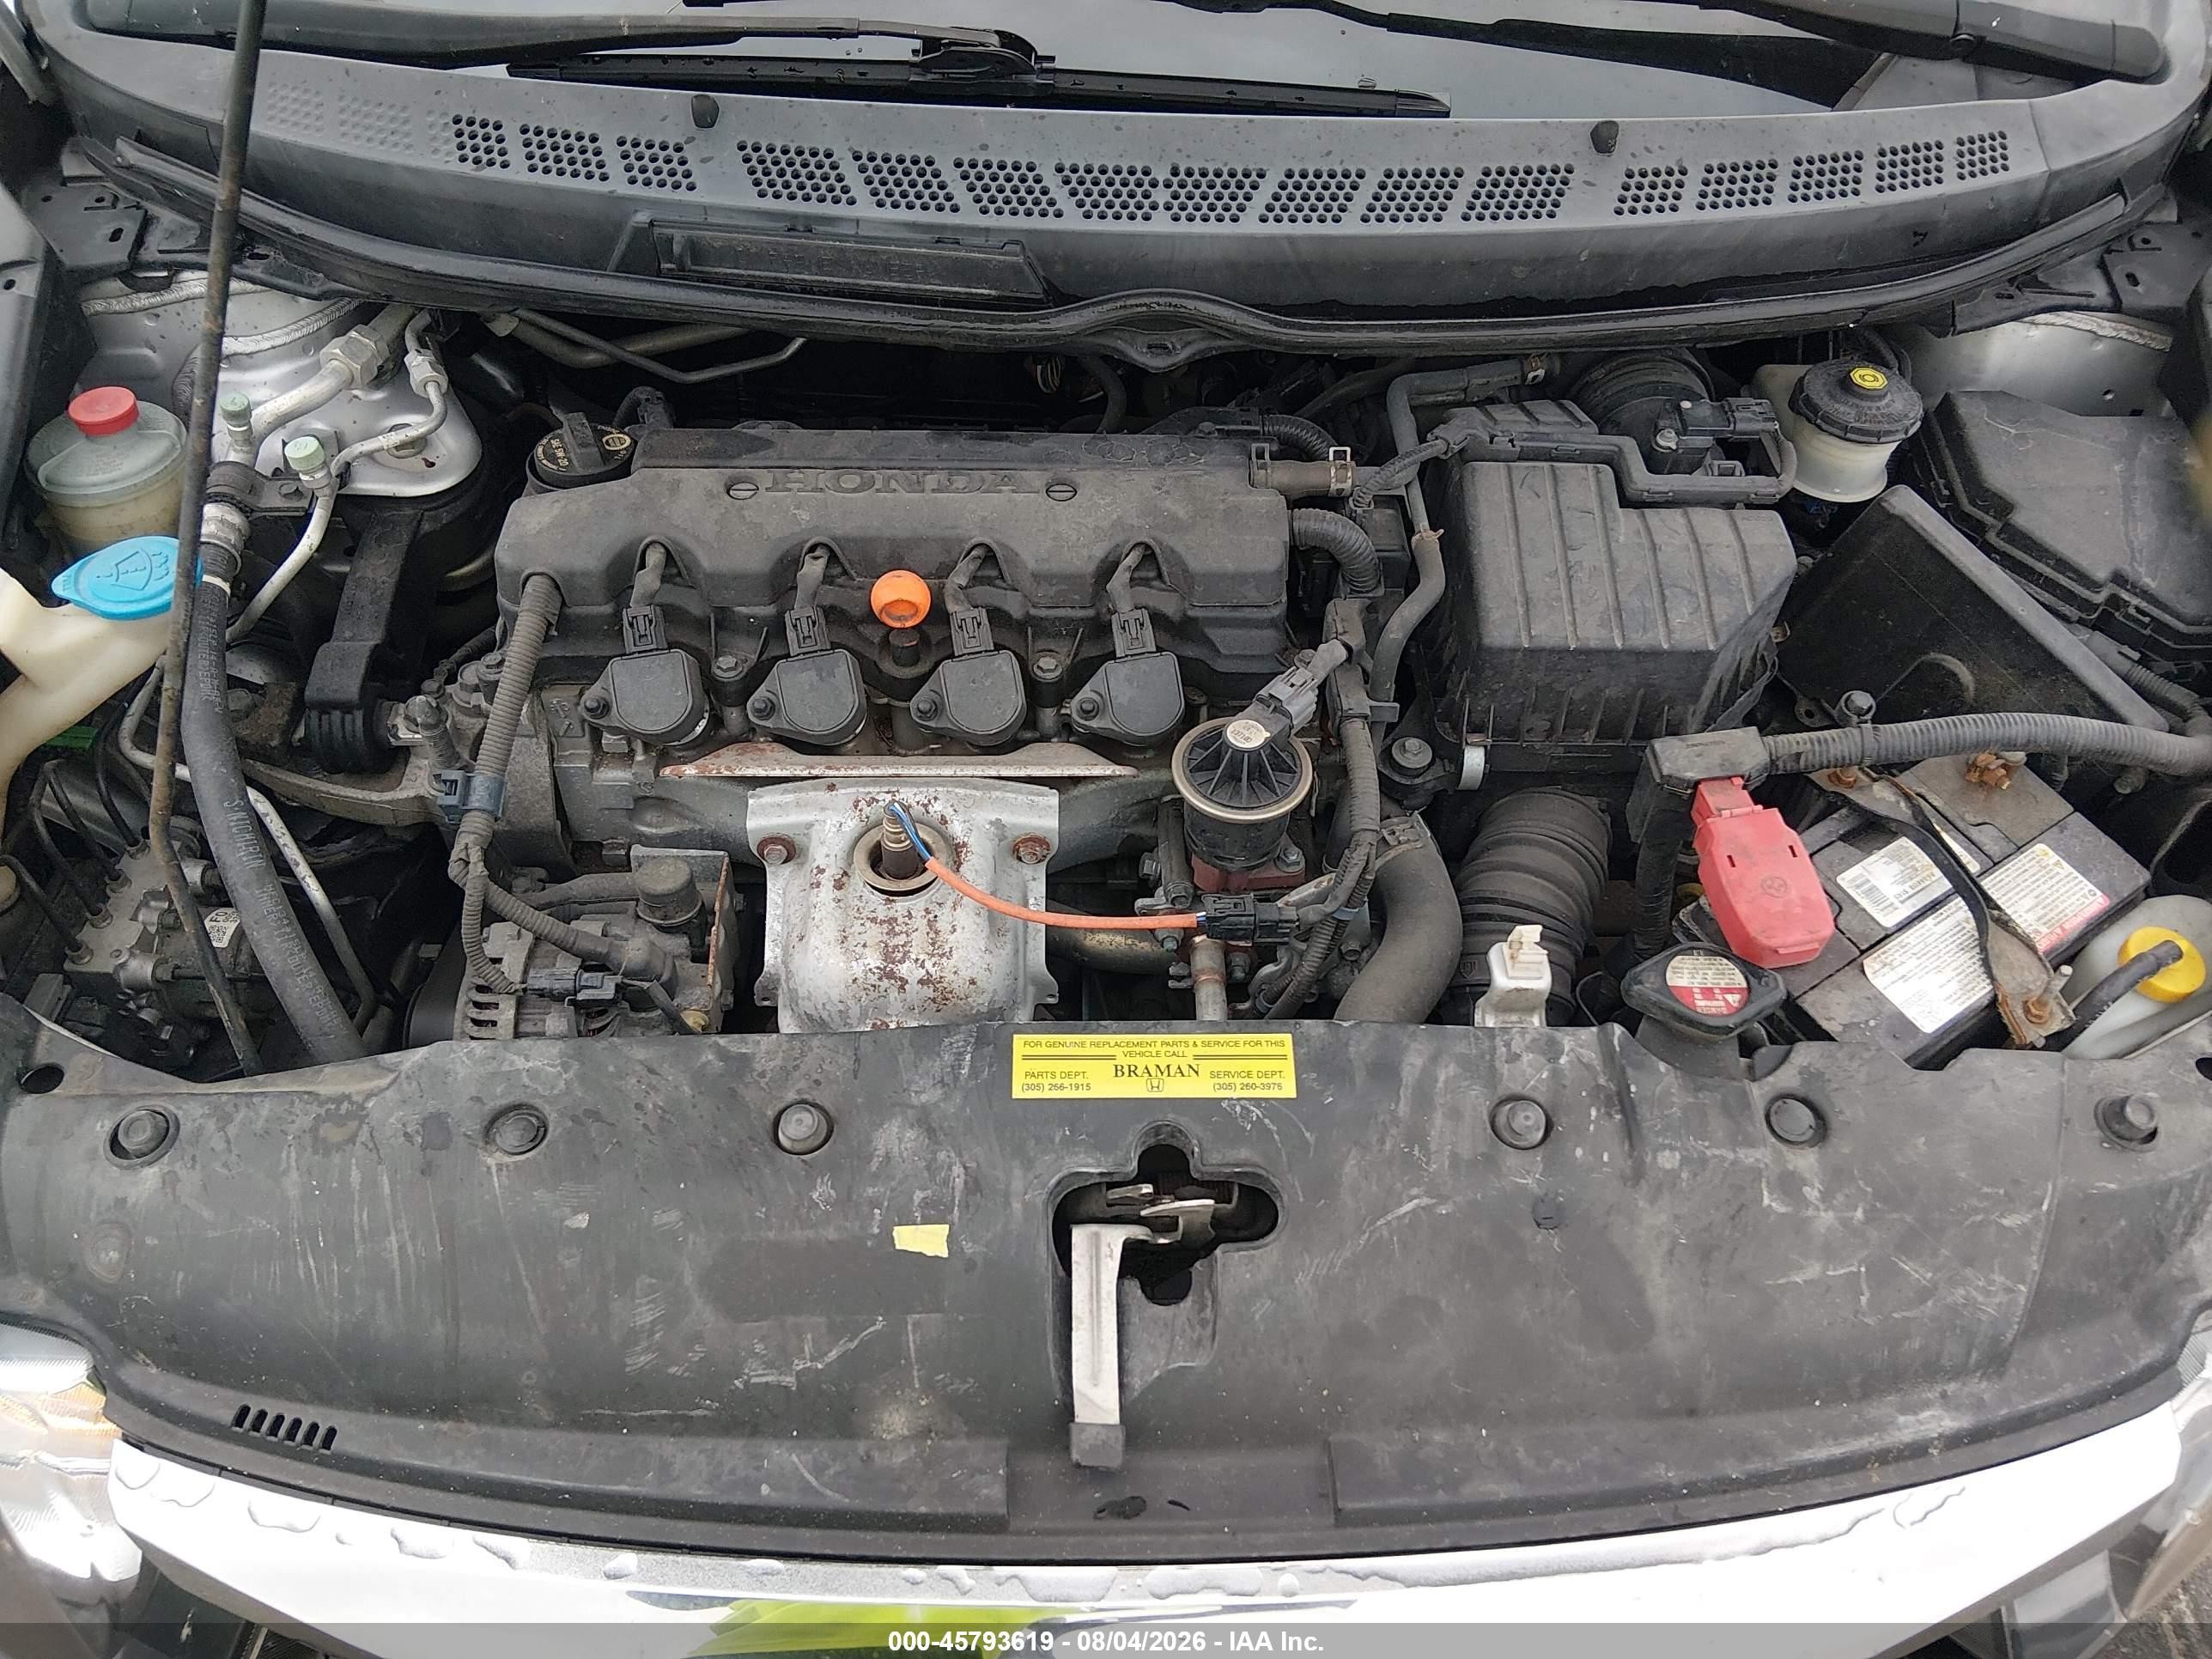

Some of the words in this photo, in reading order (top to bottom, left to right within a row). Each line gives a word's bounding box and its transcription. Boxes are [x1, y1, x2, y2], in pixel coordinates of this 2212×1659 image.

[765, 470, 1040, 494] HONDA
[1023, 1040, 1042, 1048] FOR
[1045, 1040, 1086, 1048] GENUINE
[1090, 1040, 1158, 1048] REPLACEMENT
[1160, 1040, 1189, 1048] PARTS
[1024, 1071, 1057, 1079] PARTS
[1060, 1071, 1090, 1079] DEPT.
[1113, 1063, 1201, 1079] BRAMAN
[1209, 1070, 1254, 1079] SERVICE
[1256, 1070, 1285, 1079] DEPT.
[1021, 1083, 1045, 1093] (305)
[1212, 1082, 1237, 1093] (305)
[1239, 1082, 1283, 1091] 260-3976
